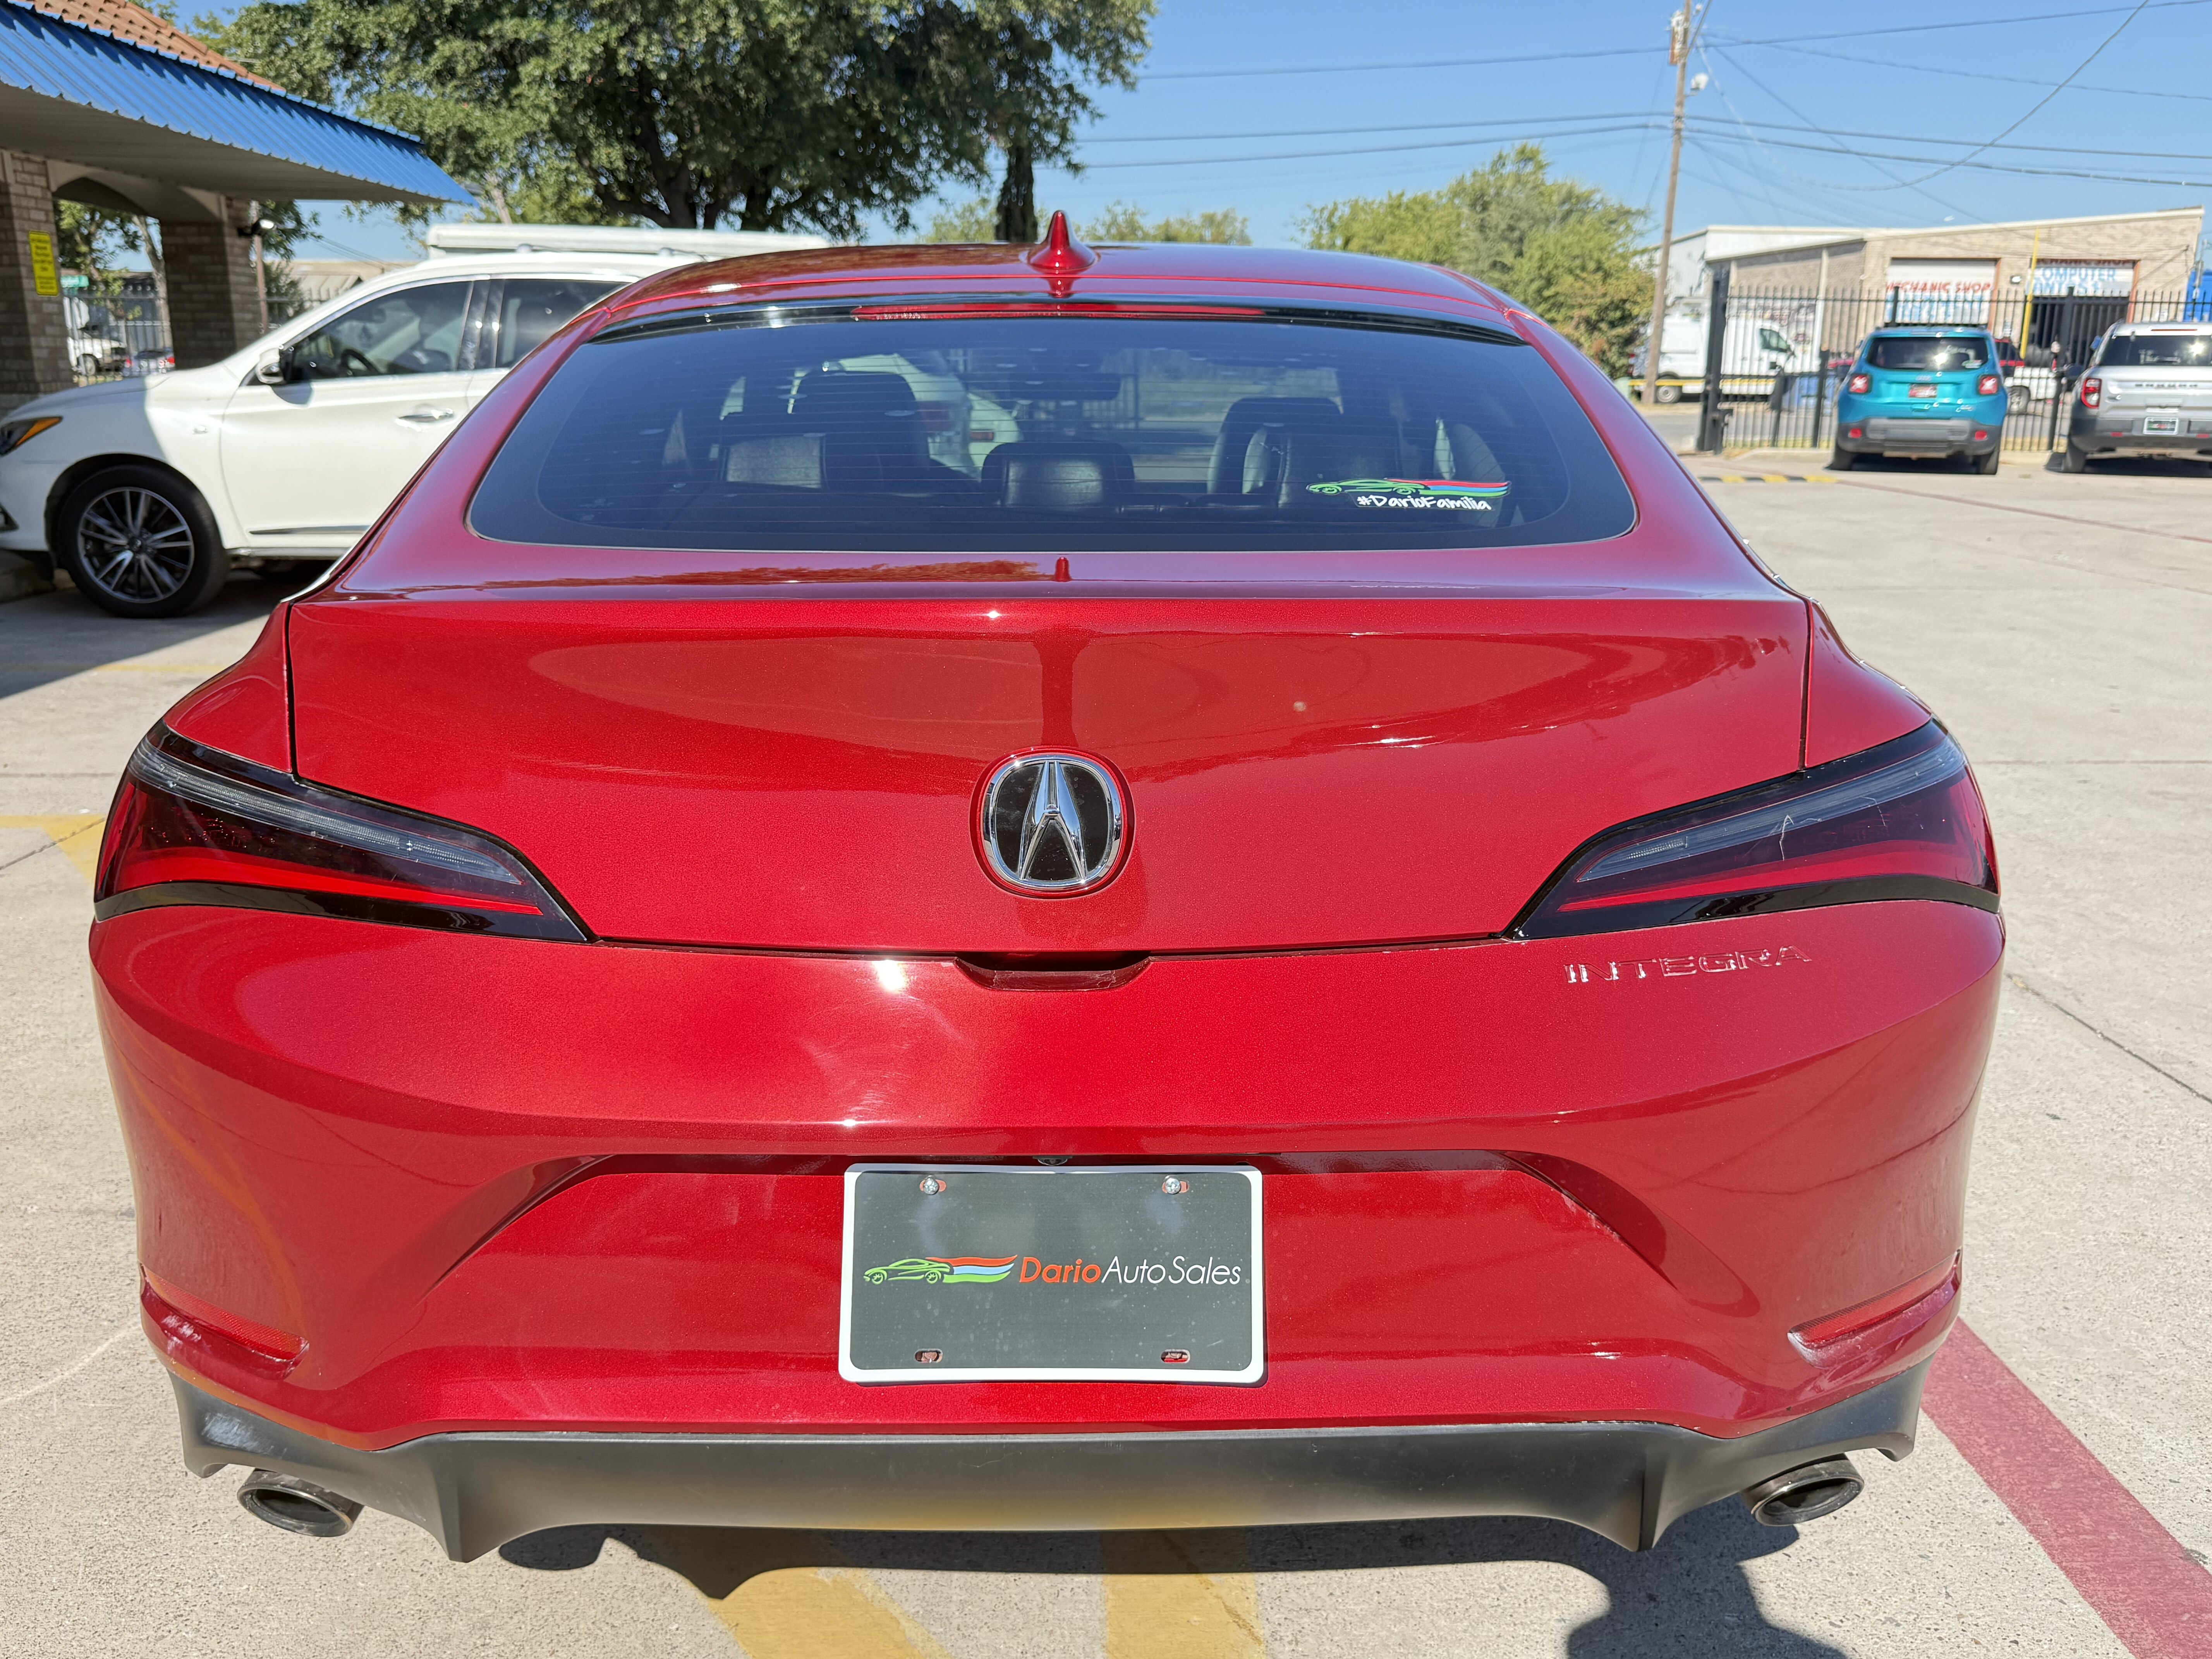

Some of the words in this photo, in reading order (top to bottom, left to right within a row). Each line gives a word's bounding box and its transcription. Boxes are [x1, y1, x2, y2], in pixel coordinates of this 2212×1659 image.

[1956, 282, 1991, 293] SHOP
[1357, 495, 1492, 510] #DarioFamilia
[1564, 946, 1813, 983] INTEGRA
